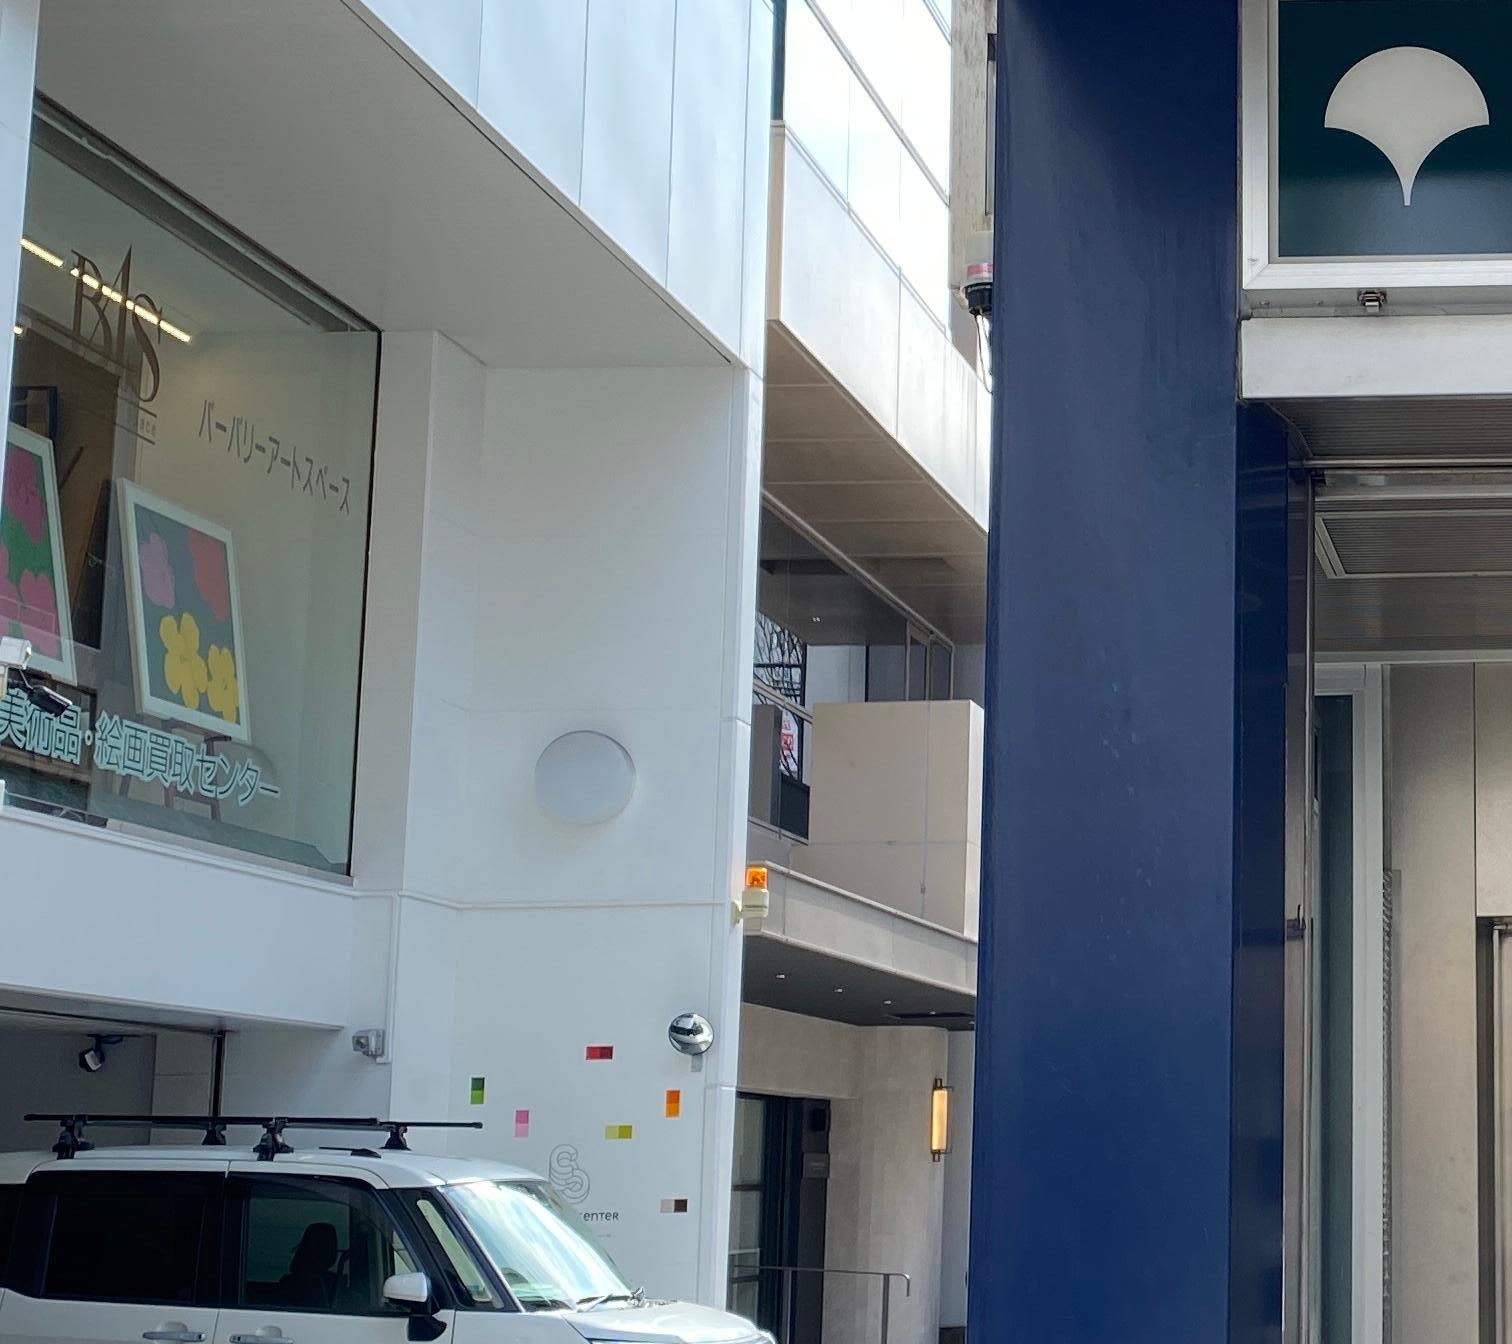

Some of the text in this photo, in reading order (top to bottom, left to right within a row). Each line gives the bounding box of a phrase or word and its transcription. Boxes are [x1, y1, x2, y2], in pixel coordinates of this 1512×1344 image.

[199, 400, 350, 515] バーバリーアートスペース
